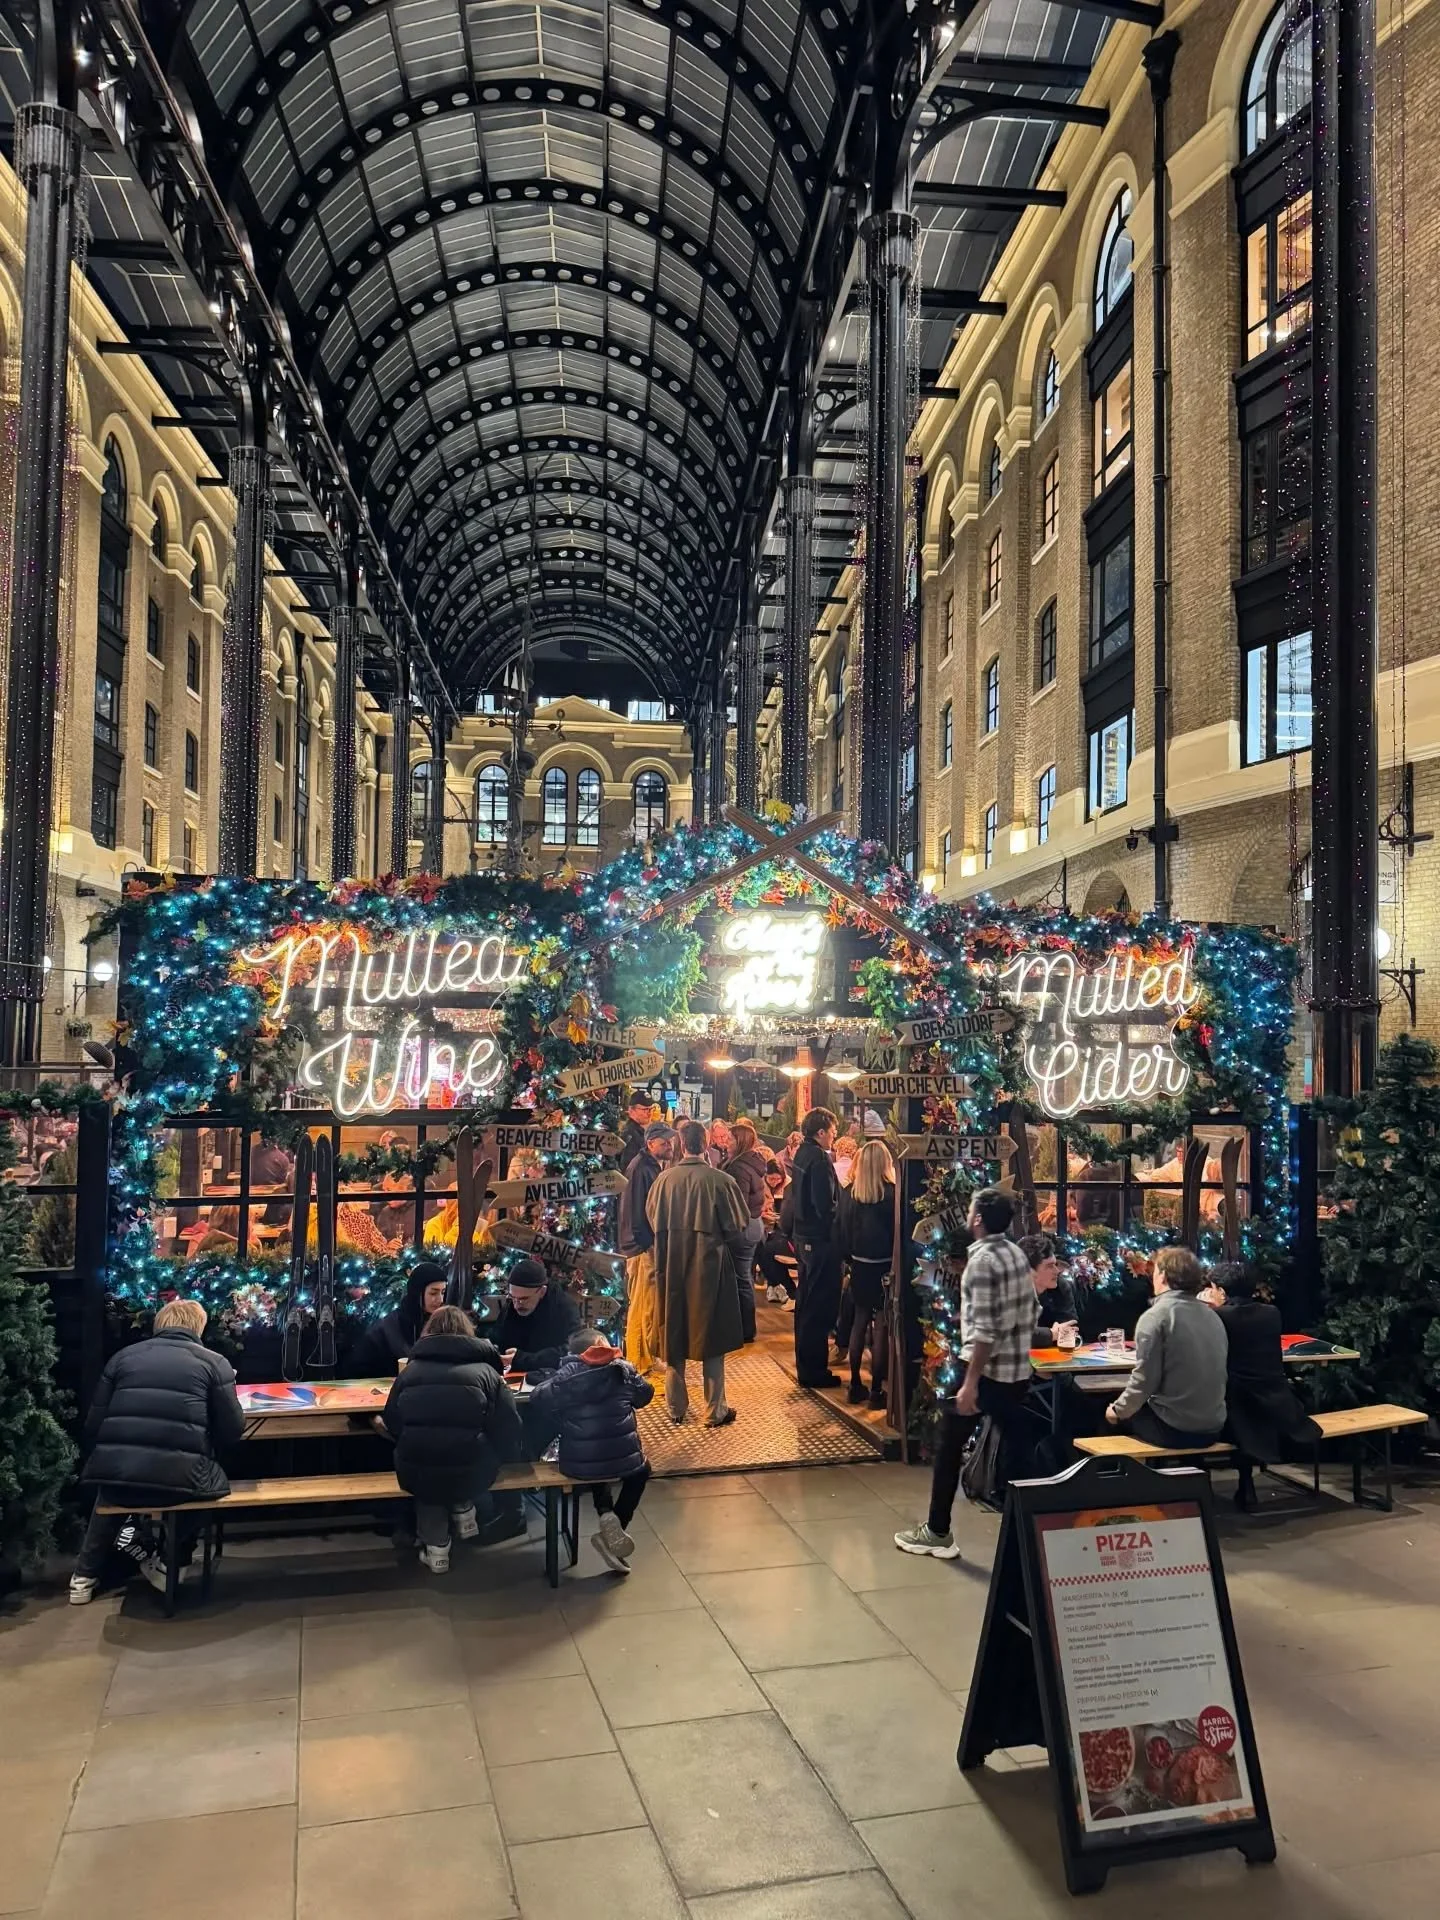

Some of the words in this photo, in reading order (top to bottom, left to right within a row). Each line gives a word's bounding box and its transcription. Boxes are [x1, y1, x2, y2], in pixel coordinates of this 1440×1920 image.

[981, 946, 1201, 1037] Mulled
[588, 1022, 637, 1046] ISTLER
[303, 1018, 504, 1116] Wine
[572, 1070, 595, 1090] VAL
[598, 1058, 645, 1086] THORENS
[1030, 1040, 1191, 1117] Cider
[496, 1127, 552, 1148] BEAVER
[559, 1132, 604, 1153] CREEK
[925, 1139, 998, 1158] ASPEN
[524, 1179, 596, 1204] AVIEMORE
[529, 1234, 585, 1266] BANFF
[1095, 1531, 1153, 1553] PIZZA
[1202, 1715, 1231, 1728] BARREL
